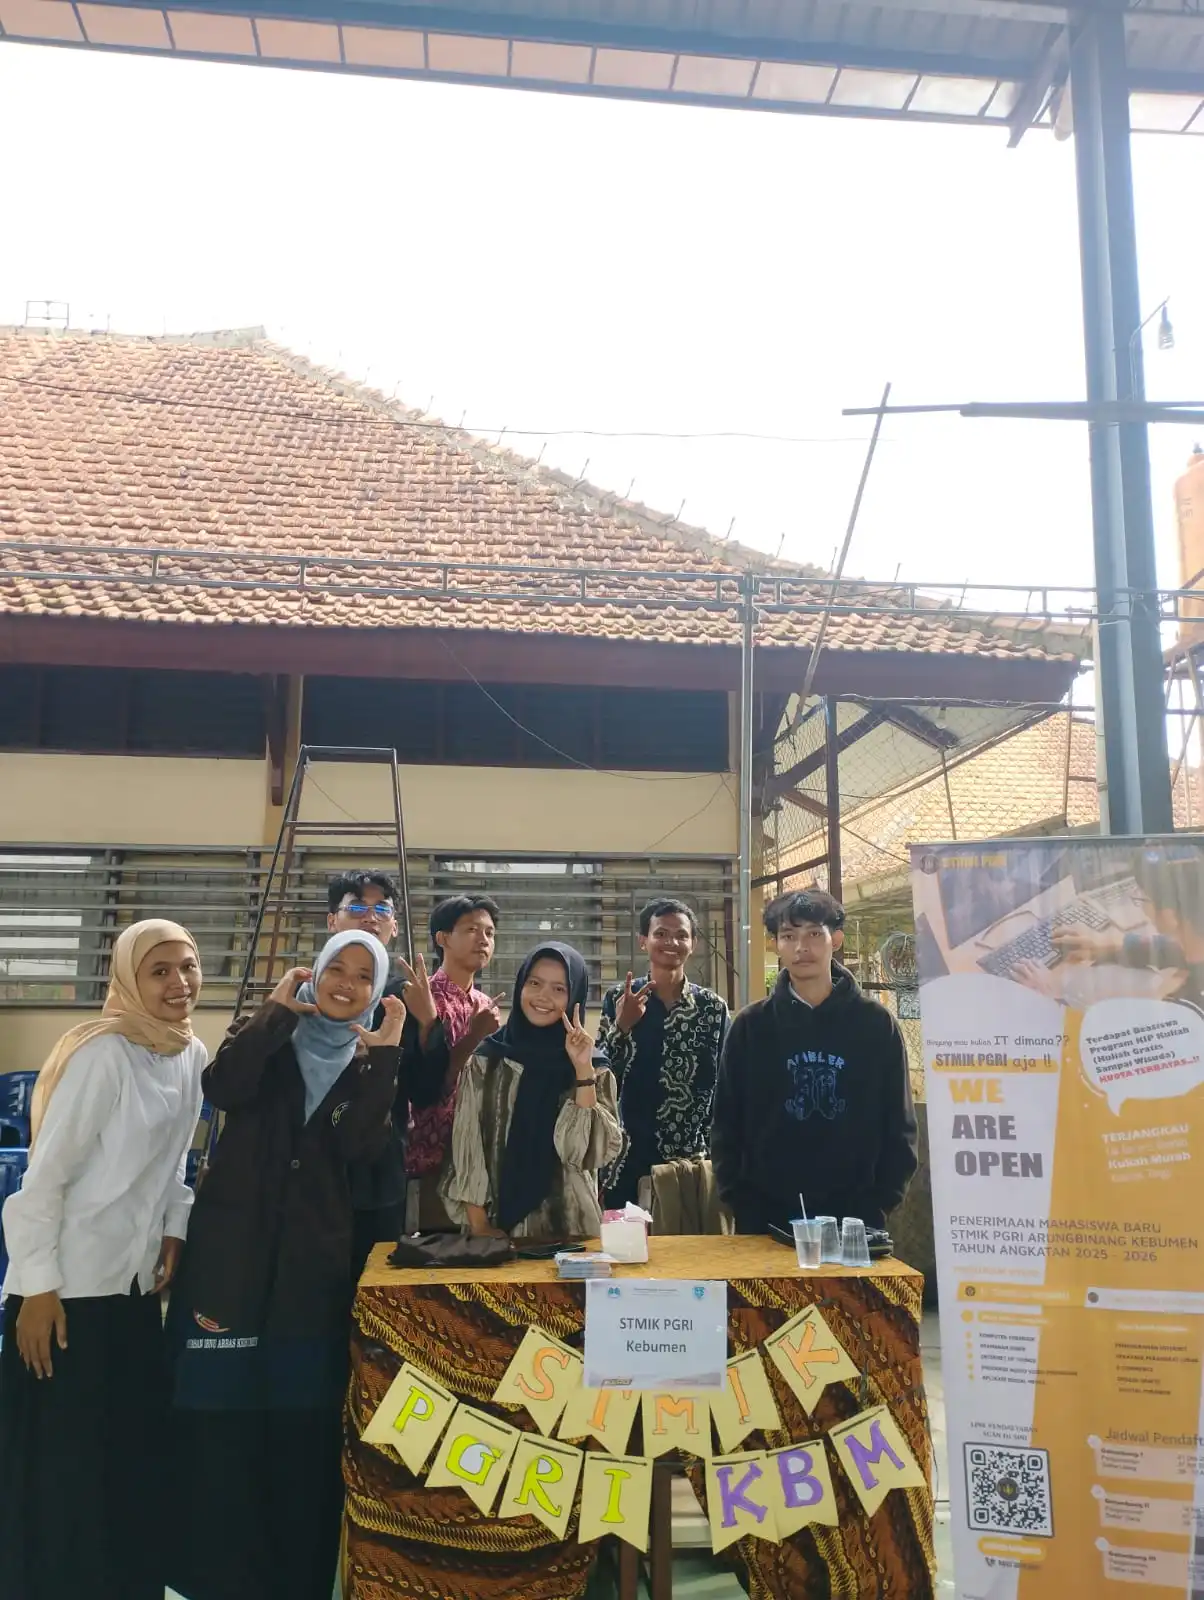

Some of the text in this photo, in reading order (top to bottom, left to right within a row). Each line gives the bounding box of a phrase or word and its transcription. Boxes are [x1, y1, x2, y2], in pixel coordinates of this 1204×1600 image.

[993, 1035, 1008, 1046] IT
[1086, 1019, 1178, 1044] Terdapat Beasiswa
[1089, 1026, 1190, 1055] Program KIP Kuliah
[935, 1053, 975, 1067] STMIK
[977, 1053, 1008, 1067] PGRI
[1013, 1054, 1037, 1071] aja
[1093, 1043, 1164, 1064] (Kuliah Gratis
[1095, 1051, 1176, 1074] Sampai Wisuda)
[1099, 1070, 1134, 1085] KUOTA
[949, 1078, 1005, 1104] WE
[952, 1114, 1017, 1140] ARE
[1101, 1123, 1189, 1144] TERJANGKAU
[955, 1150, 1043, 1178] OPEN
[950, 1215, 1162, 1233] PENERIMAAN MAHASISWA BARU
[951, 1229, 1199, 1249] STMIK PGRI ARUNGBINANG KEBUMEN
[952, 1242, 1001, 1255] TAHUN
[1000, 1244, 1071, 1258] ANGKATAN
[1075, 1248, 1108, 1260] 2025
[1123, 1250, 1158, 1262] 2026
[619, 1317, 693, 1331] STMIK PGRI
[626, 1340, 687, 1353] Kebumen
[1106, 1427, 1149, 1442] Jadwal
[393, 1385, 632, 1523] PGRI
[716, 1419, 906, 1528] KBM
